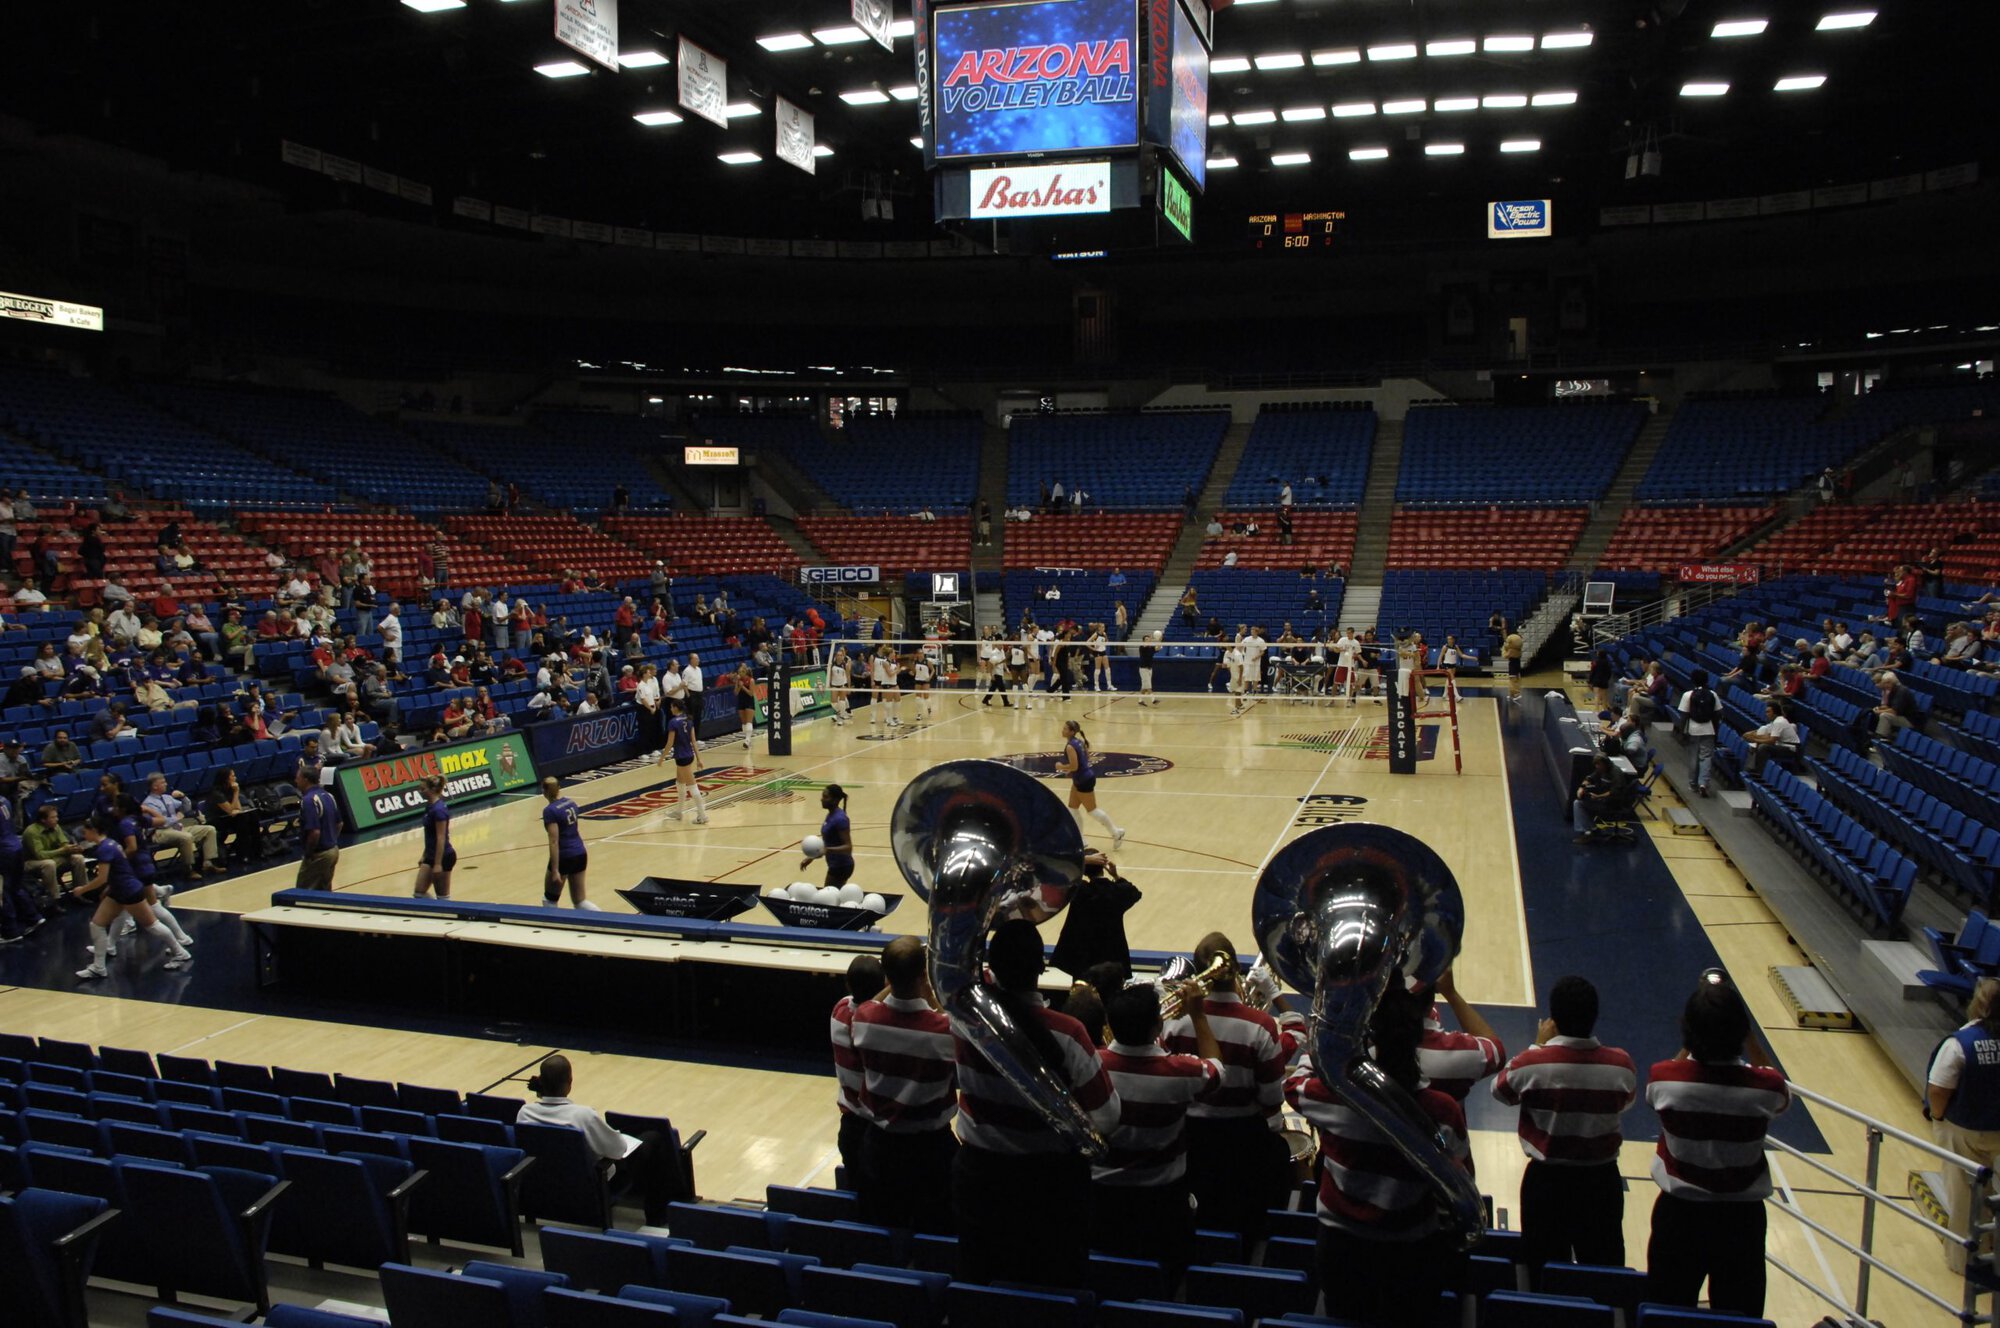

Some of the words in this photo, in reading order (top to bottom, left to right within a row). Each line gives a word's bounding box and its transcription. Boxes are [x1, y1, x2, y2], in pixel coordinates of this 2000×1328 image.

[943, 39, 1129, 87] ARIZONA
[918, 48, 930, 127] DOWN
[943, 75, 1133, 113] VOLLEYBALL
[977, 174, 1104, 210] Bashas'
[1506, 205, 1535, 213] Tucson
[1509, 211, 1541, 219] Electric
[1249, 215, 1277, 223] ARIZONA
[1303, 211, 1345, 221] WASHINGTON
[1512, 218, 1541, 226] Power
[1264, 224, 1272, 236] 0
[1325, 221, 1333, 233] 0
[1285, 235, 1309, 247] 6:00
[808, 568, 873, 582] GEICO
[773, 671, 781, 739] ARIZONA
[359, 752, 440, 792] BRAKE
[441, 748, 490, 774] max
[375, 795, 404, 814] CAR
[441, 773, 492, 798] CENTERS
[566, 807, 577, 825] 21
[654, 896, 697, 908] molten
[789, 904, 829, 919] molten
